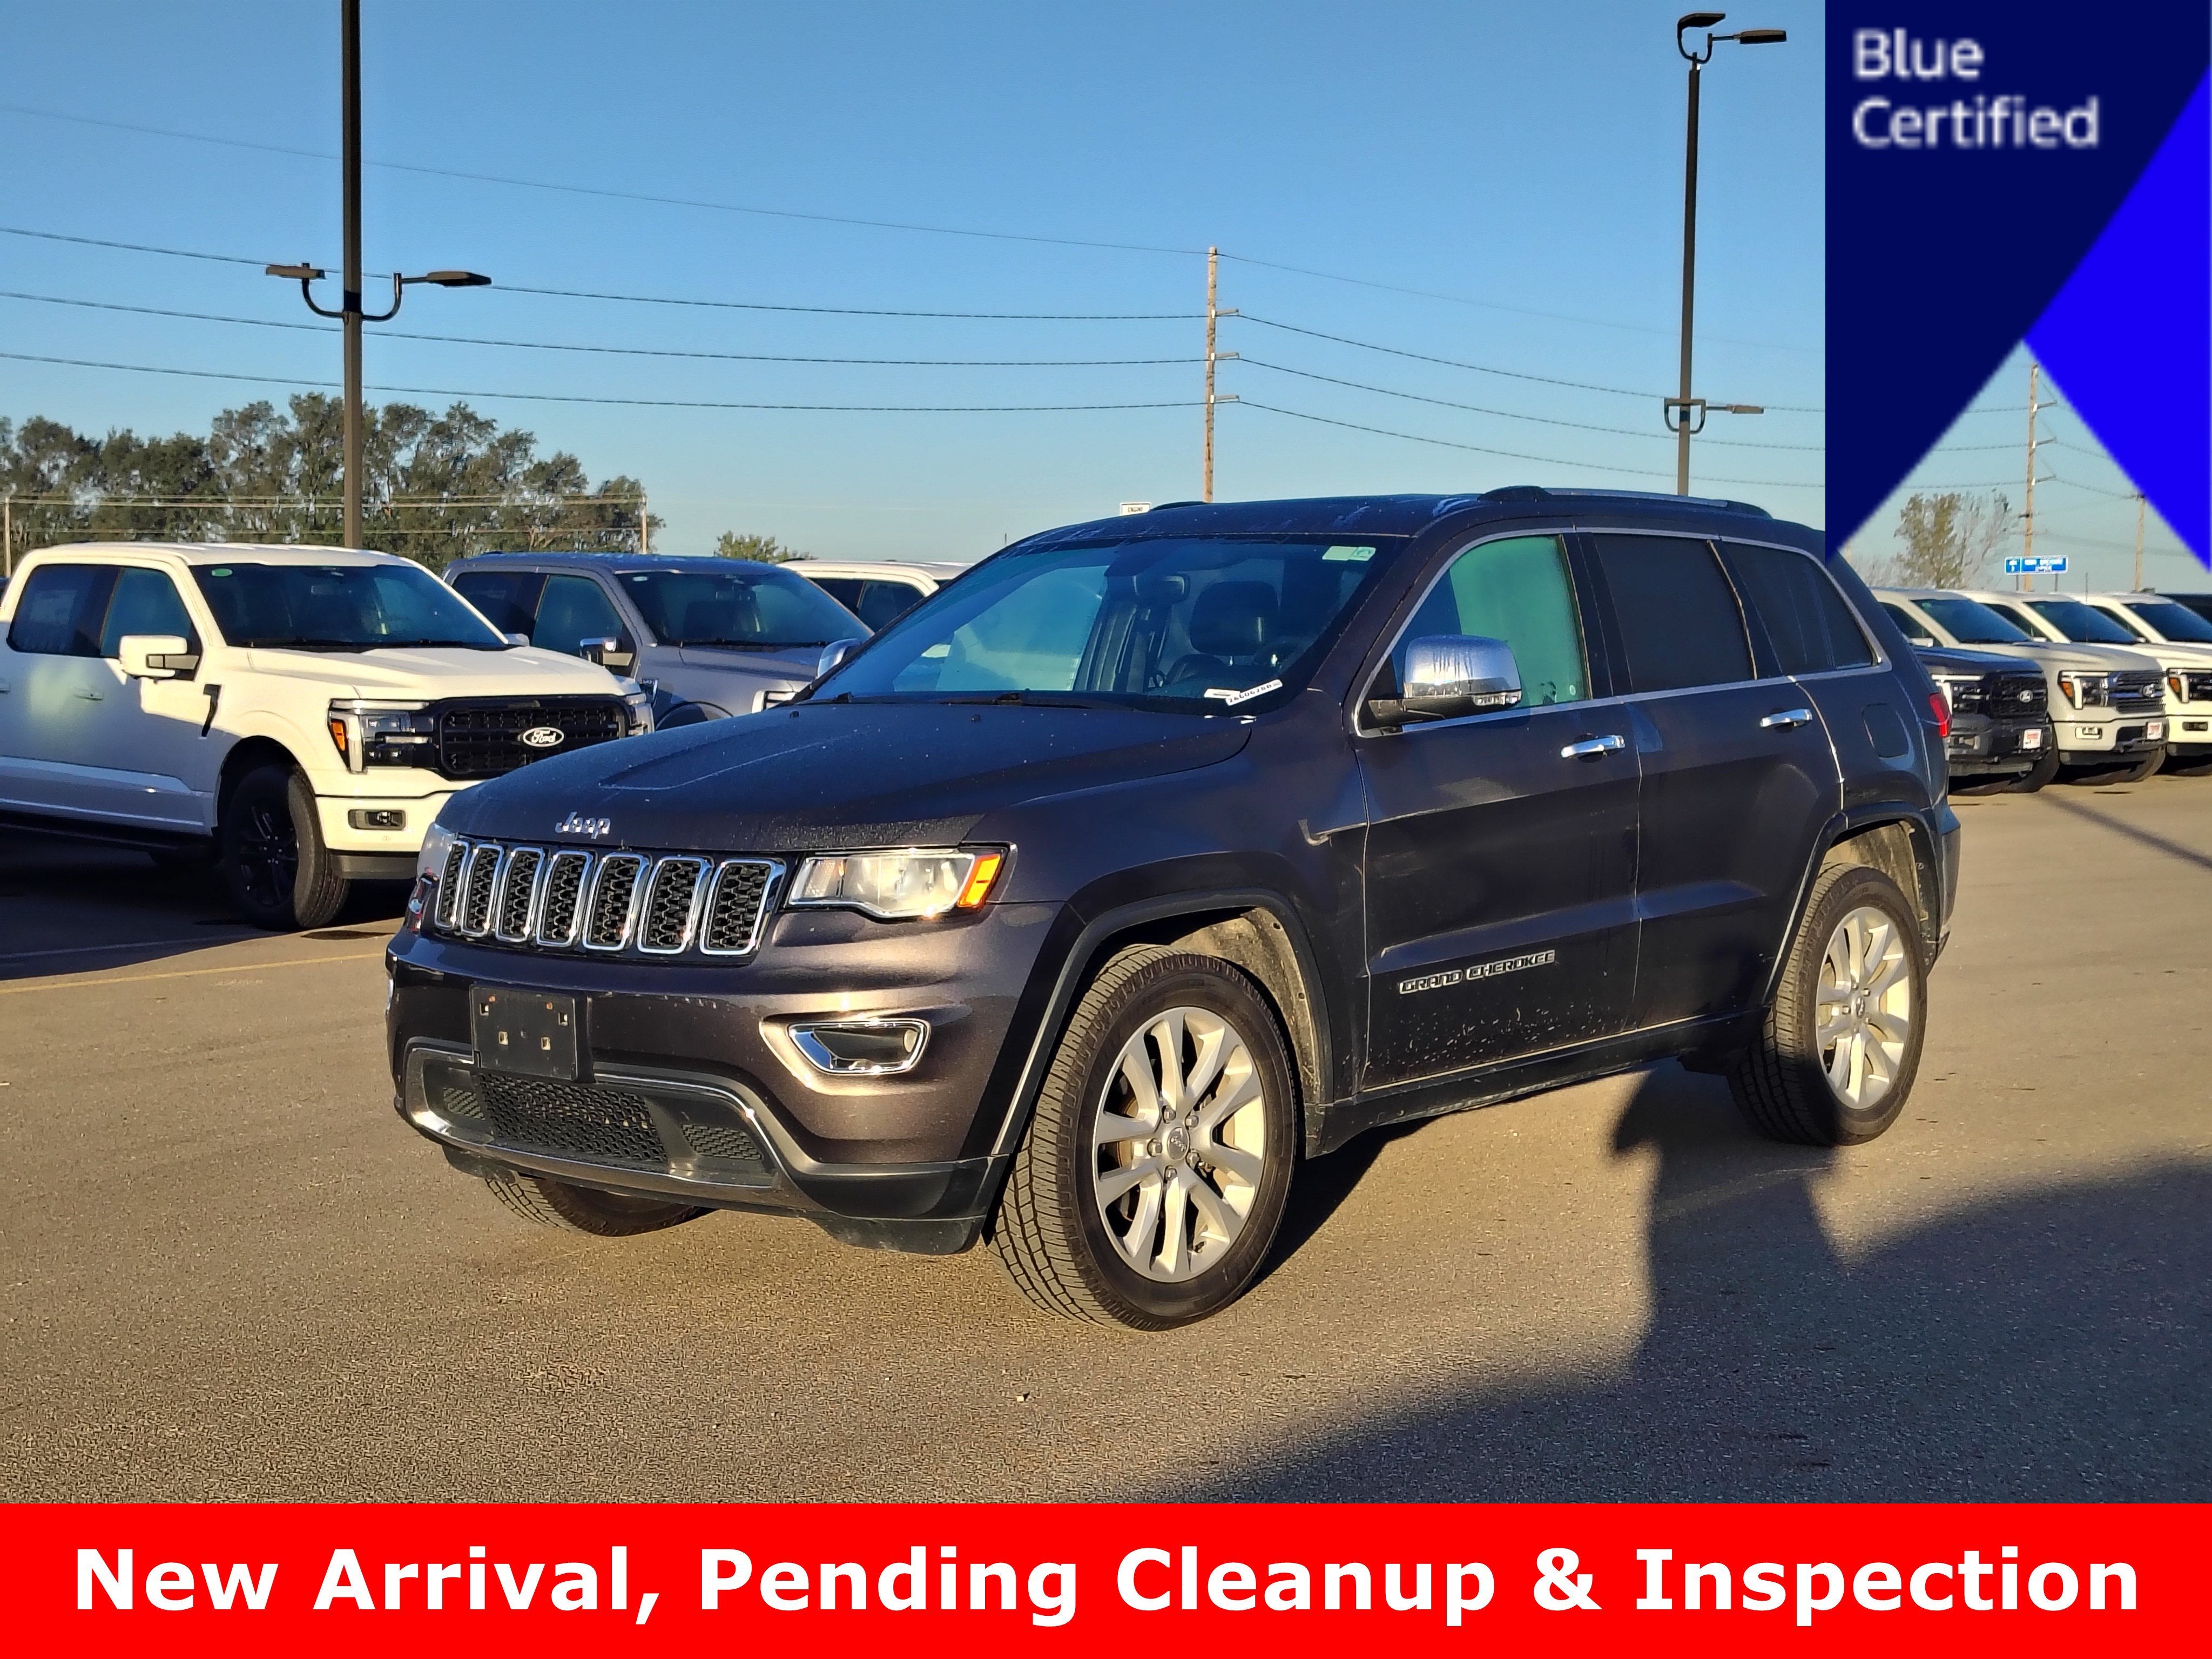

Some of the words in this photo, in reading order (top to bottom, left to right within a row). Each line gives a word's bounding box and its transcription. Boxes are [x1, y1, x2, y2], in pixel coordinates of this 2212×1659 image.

[531, 730, 556, 744] Ford
[555, 811, 611, 840] Jeep
[1399, 969, 1463, 995] GRAND
[1466, 949, 1555, 981] CHEROKEE
